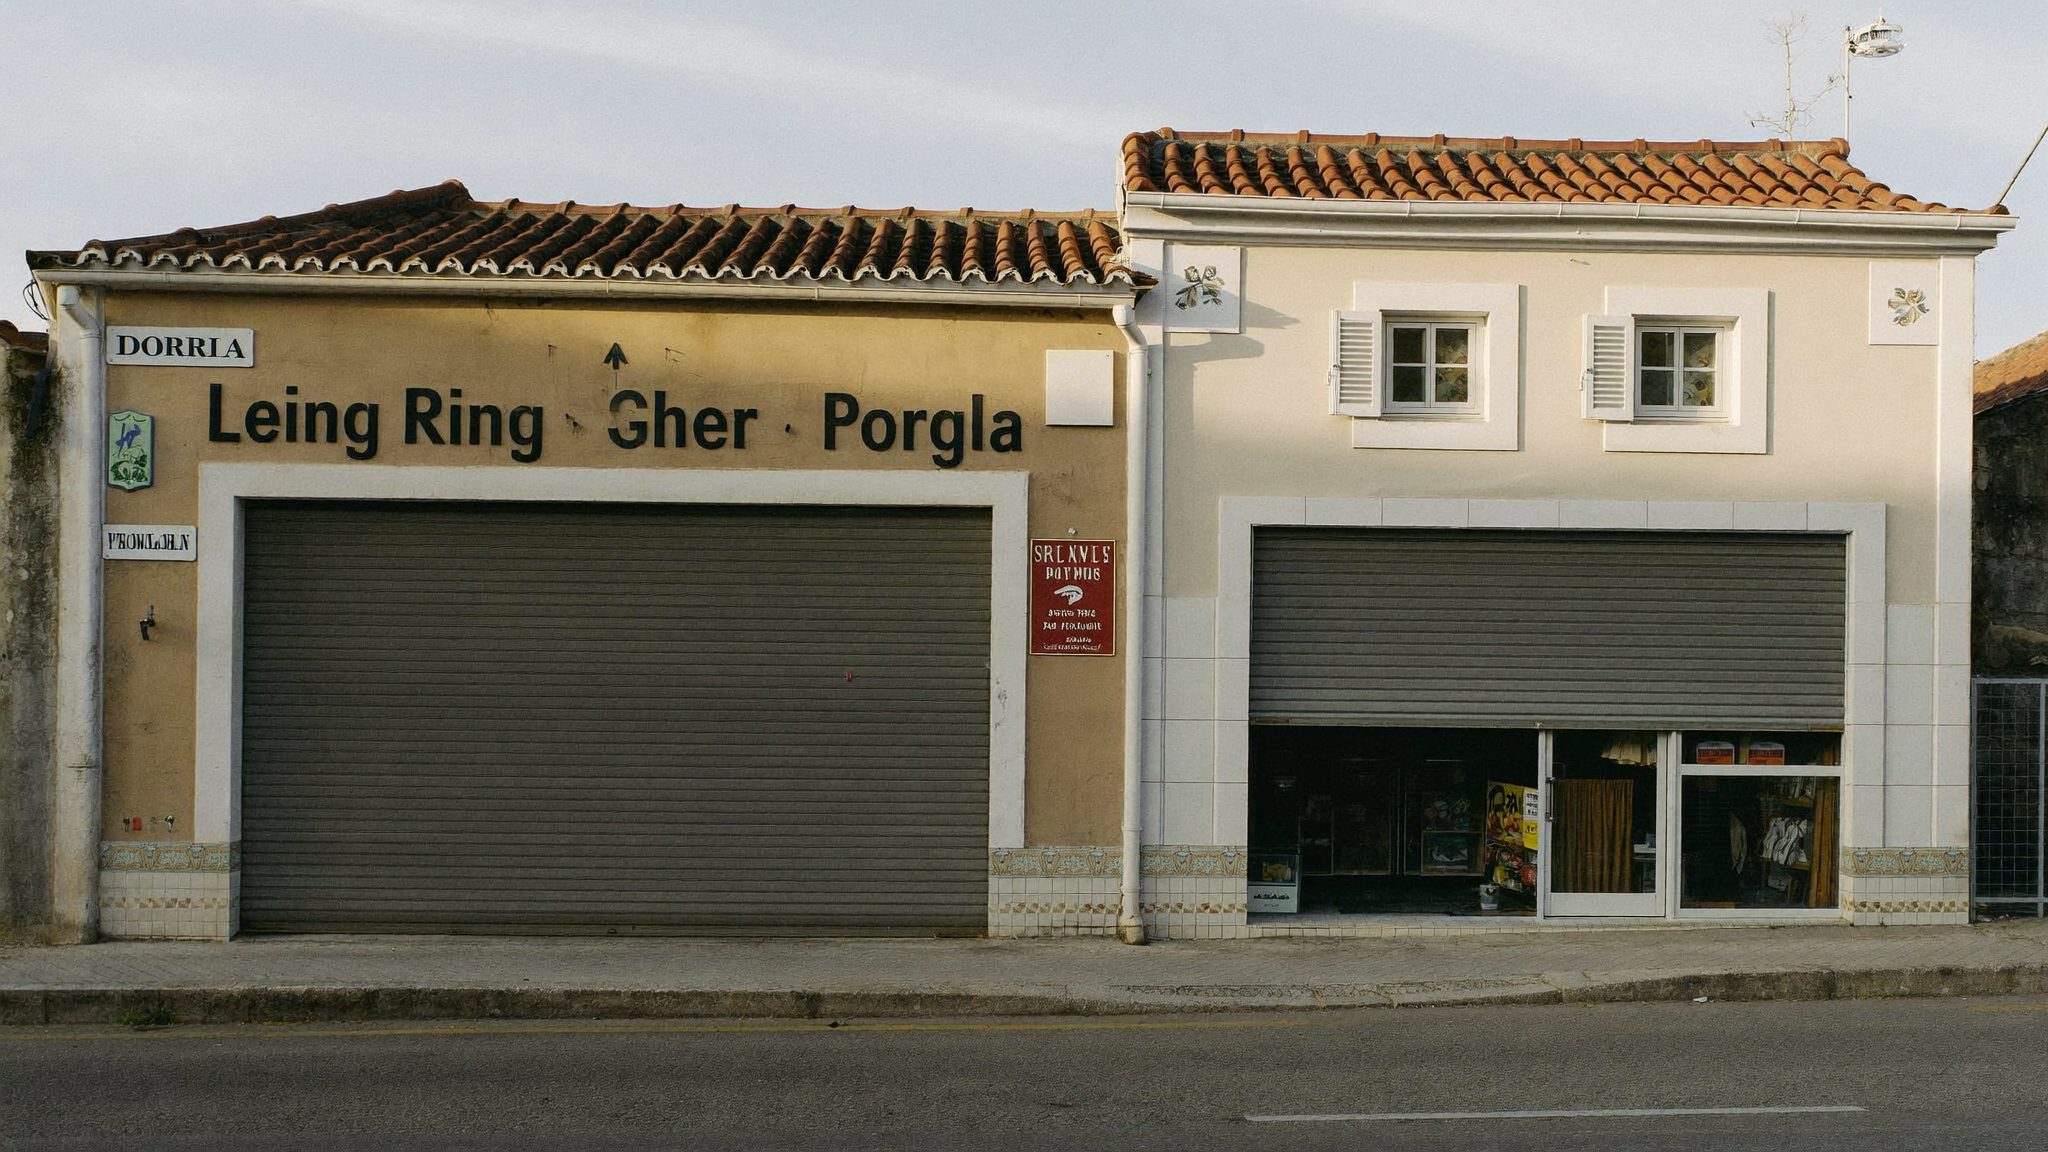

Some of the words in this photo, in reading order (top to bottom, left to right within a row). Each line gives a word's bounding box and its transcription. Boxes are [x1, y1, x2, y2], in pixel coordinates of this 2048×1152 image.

[116, 334, 246, 359] DORRIA
[208, 383, 380, 461] Leing
[404, 387, 544, 463] Ring
[607, 389, 758, 450] Gher
[824, 392, 1023, 469] Porgla
